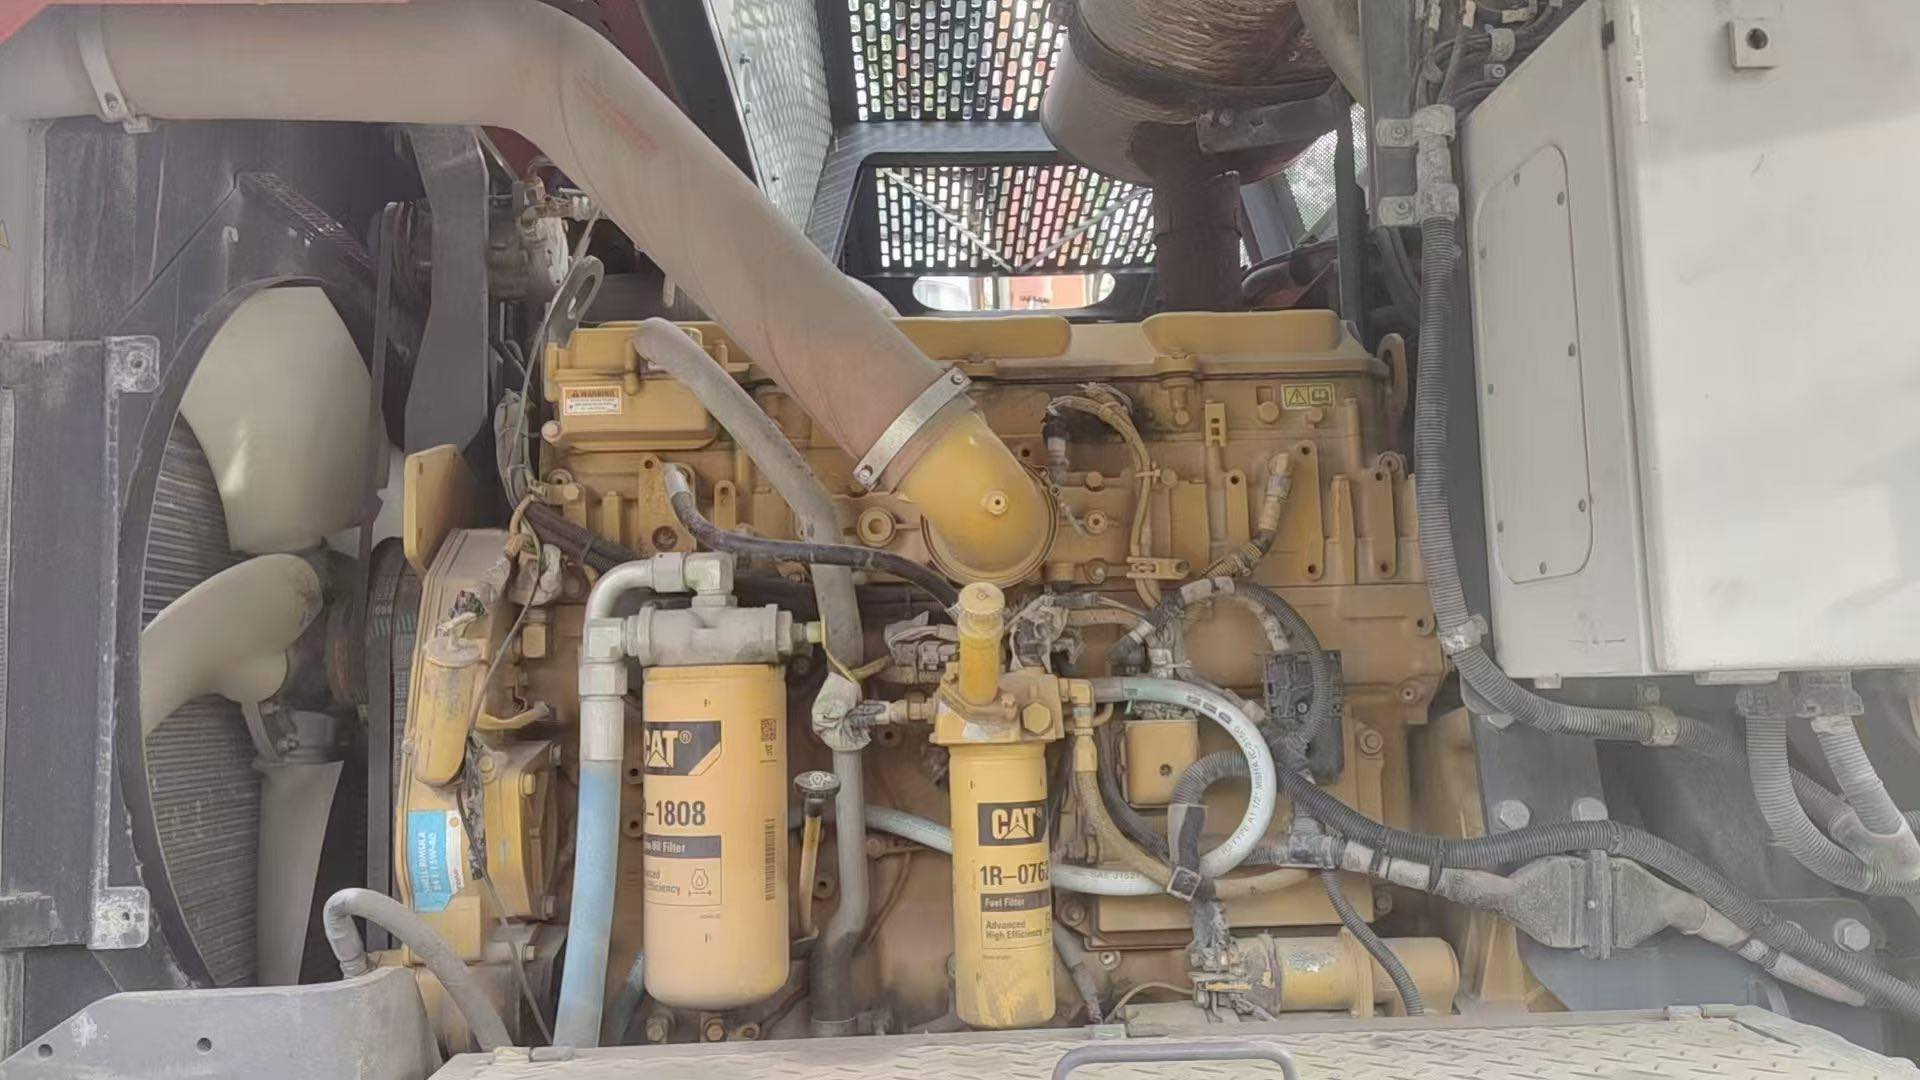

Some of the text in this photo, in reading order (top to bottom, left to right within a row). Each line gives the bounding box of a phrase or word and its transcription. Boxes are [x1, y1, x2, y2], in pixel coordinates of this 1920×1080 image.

[643, 800, 706, 826] -1808
[991, 808, 1036, 840] CAT
[662, 841, 686, 853] Filter
[984, 897, 1026, 908] Fuel Filter
[985, 919, 1027, 930] Advanced
[986, 929, 1044, 942] High Efficiency
